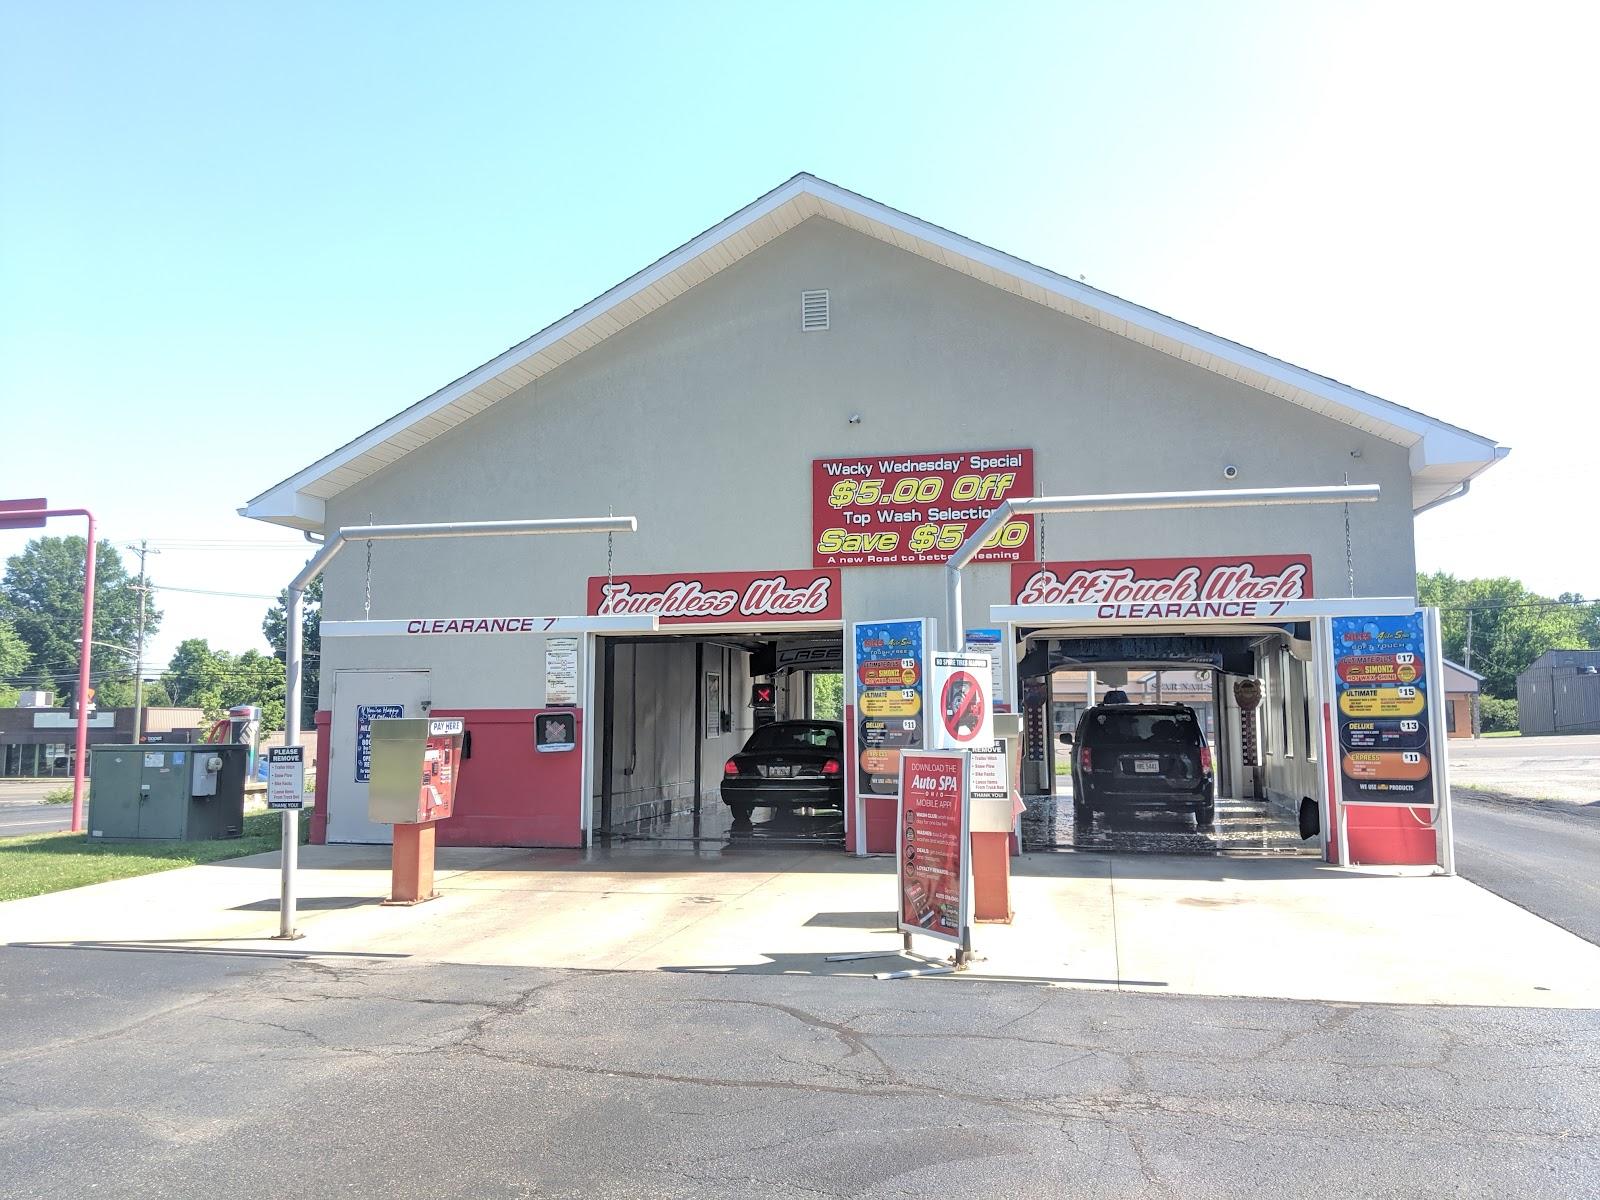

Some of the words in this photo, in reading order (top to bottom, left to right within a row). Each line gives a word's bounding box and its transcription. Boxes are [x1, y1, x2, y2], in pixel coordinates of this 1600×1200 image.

[970, 453, 1022, 471] Special
[829, 476, 944, 509] $5.00
[951, 473, 1016, 501] Off
[843, 511, 871, 526] Top
[877, 509, 922, 523] Wash
[817, 528, 900, 554] Save
[827, 556, 837, 564] A
[867, 555, 898, 563] Road
[901, 554, 915, 562] to
[1201, 562, 1307, 602] Wash
[597, 581, 739, 617] Touchless
[739, 576, 832, 616] Wash
[1097, 602, 1257, 619] CLEARANCE
[407, 618, 534, 634] CLEARANCE
[902, 659, 914, 667] $15
[1397, 654, 1413, 662] $17
[1364, 664, 1394, 674] SIMONIZ
[902, 690, 914, 698] $13
[1399, 688, 1415, 696] $15
[433, 722, 445, 731] PAY
[445, 721, 460, 730] HERE
[904, 721, 915, 729] $11
[1349, 722, 1375, 730] DELUXE
[1401, 722, 1418, 730] $13
[1404, 753, 1419, 762] $11
[911, 763, 945, 773] DOWNLOAD
[945, 764, 957, 773] THE
[911, 774, 937, 790] Auto
[938, 775, 958, 792] SPA
[915, 799, 939, 808] MOBILE
